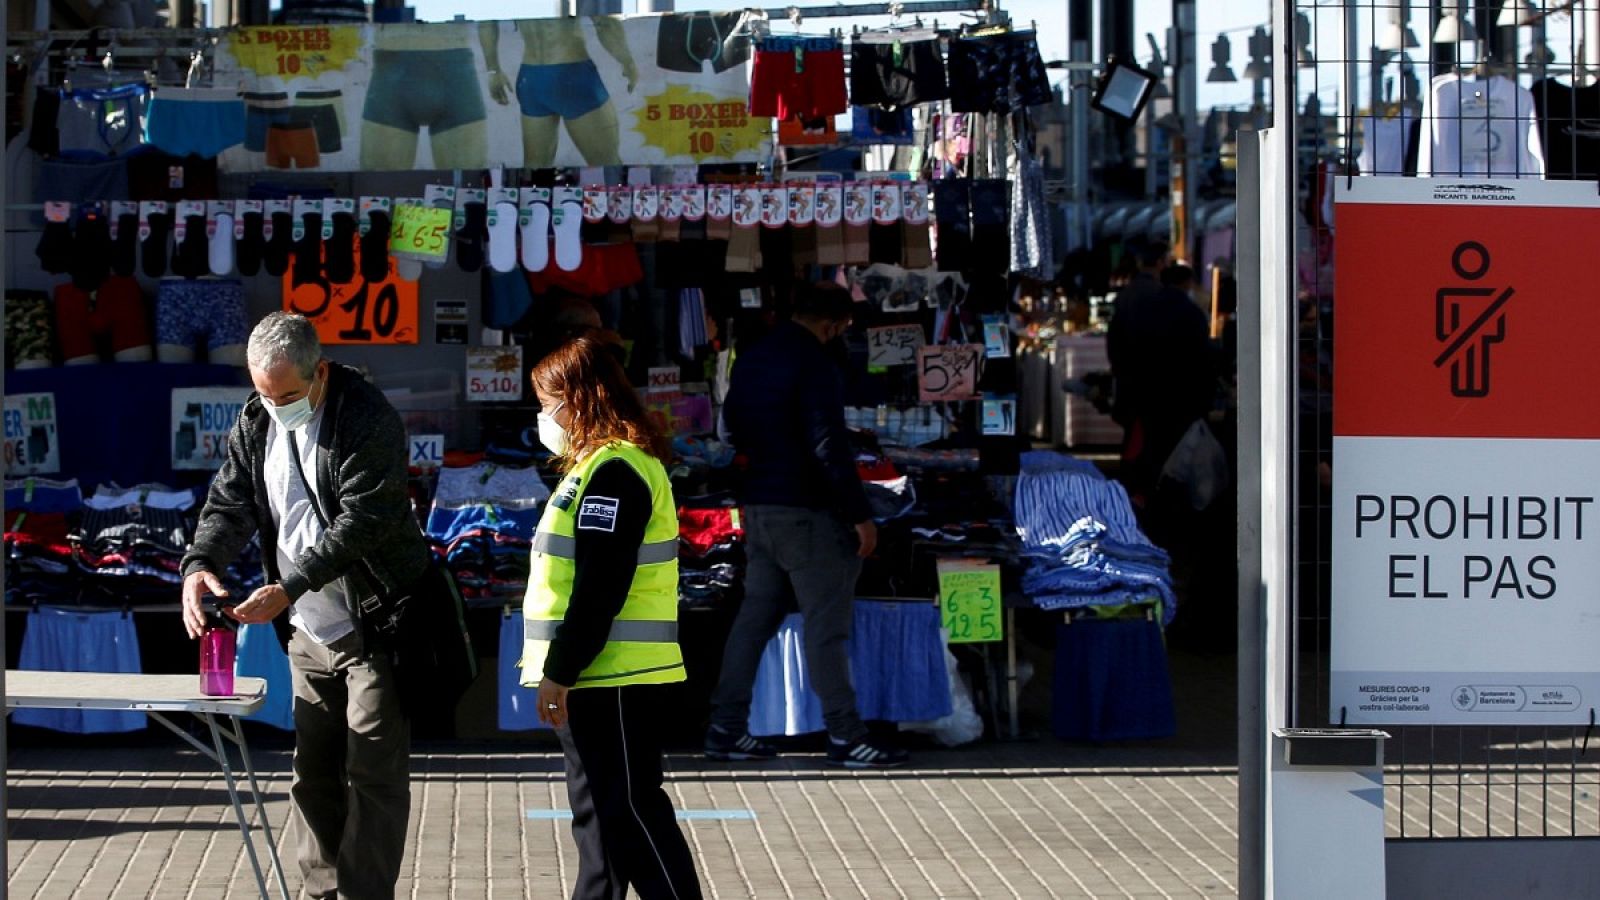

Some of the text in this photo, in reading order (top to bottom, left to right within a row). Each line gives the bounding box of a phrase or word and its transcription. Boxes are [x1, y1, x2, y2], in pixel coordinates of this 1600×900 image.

[238, 29, 330, 44] 5 BOXER
[276, 54, 301, 75] 10
[647, 102, 749, 120] 5 BOXER
[688, 131, 716, 154] 10
[652, 371, 681, 386] XXL
[28, 395, 53, 421] M
[413, 440, 443, 461] XL
[1356, 495, 1593, 540] PROHIBIT
[1388, 554, 1558, 600] EL PAS
[947, 587, 994, 613] 6 3
[1359, 685, 1430, 693] MESURES COVID-19
[1359, 704, 1382, 712] vostra
[1370, 694, 1419, 704] Gràcies per la
[1479, 696, 1516, 704] Barcelona
